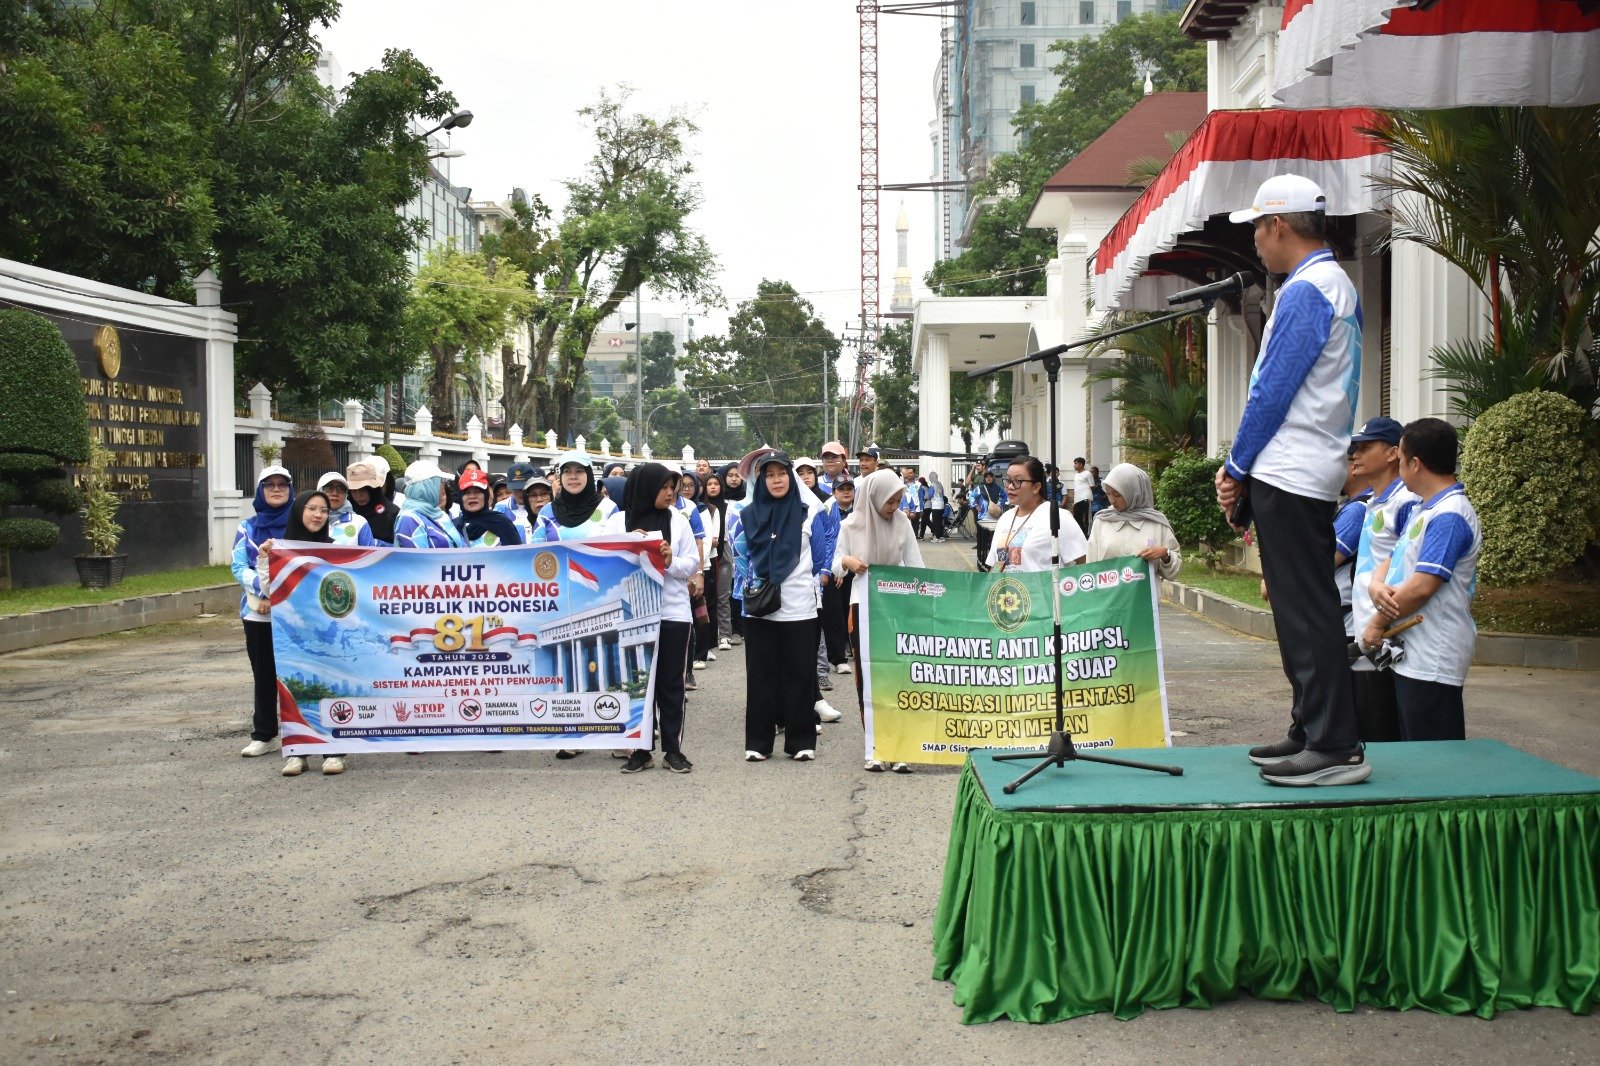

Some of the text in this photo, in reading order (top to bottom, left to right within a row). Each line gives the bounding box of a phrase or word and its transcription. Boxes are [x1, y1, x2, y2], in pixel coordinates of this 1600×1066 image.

[441, 564, 485, 582] HUT
[372, 582, 559, 600] MAHKAMAH AGUNG
[379, 599, 559, 615] REPUBLIK INDONESIA
[896, 633, 992, 659] KAMPANYE
[997, 637, 1039, 659] ANTI
[431, 653, 497, 662] TAHUN 2026
[403, 664, 531, 678] KAMPANYE PUBLIK
[910, 661, 1019, 687] GRATIFIKASI
[1066, 655, 1118, 681] SUAP
[372, 676, 565, 689] SISTEM MANAJEMEN ANTI PENYUAPAN
[898, 684, 1135, 713] SOSIALISASI IMPLEMENTASI
[357, 704, 378, 712] TOLAK
[413, 703, 445, 713] STOP
[485, 709, 520, 717] INTEGRITAS
[339, 729, 368, 737] BERSAMA
[368, 728, 382, 736] KITA
[383, 728, 416, 736] WUJUDKAN
[418, 727, 452, 735] PERADILAN
[452, 727, 485, 735] INDONESIA
[577, 725, 621, 733] BERINTEGRITAS
[945, 718, 993, 738] SMAP
[997, 719, 1021, 738] PN
[922, 743, 947, 752] SMAP
